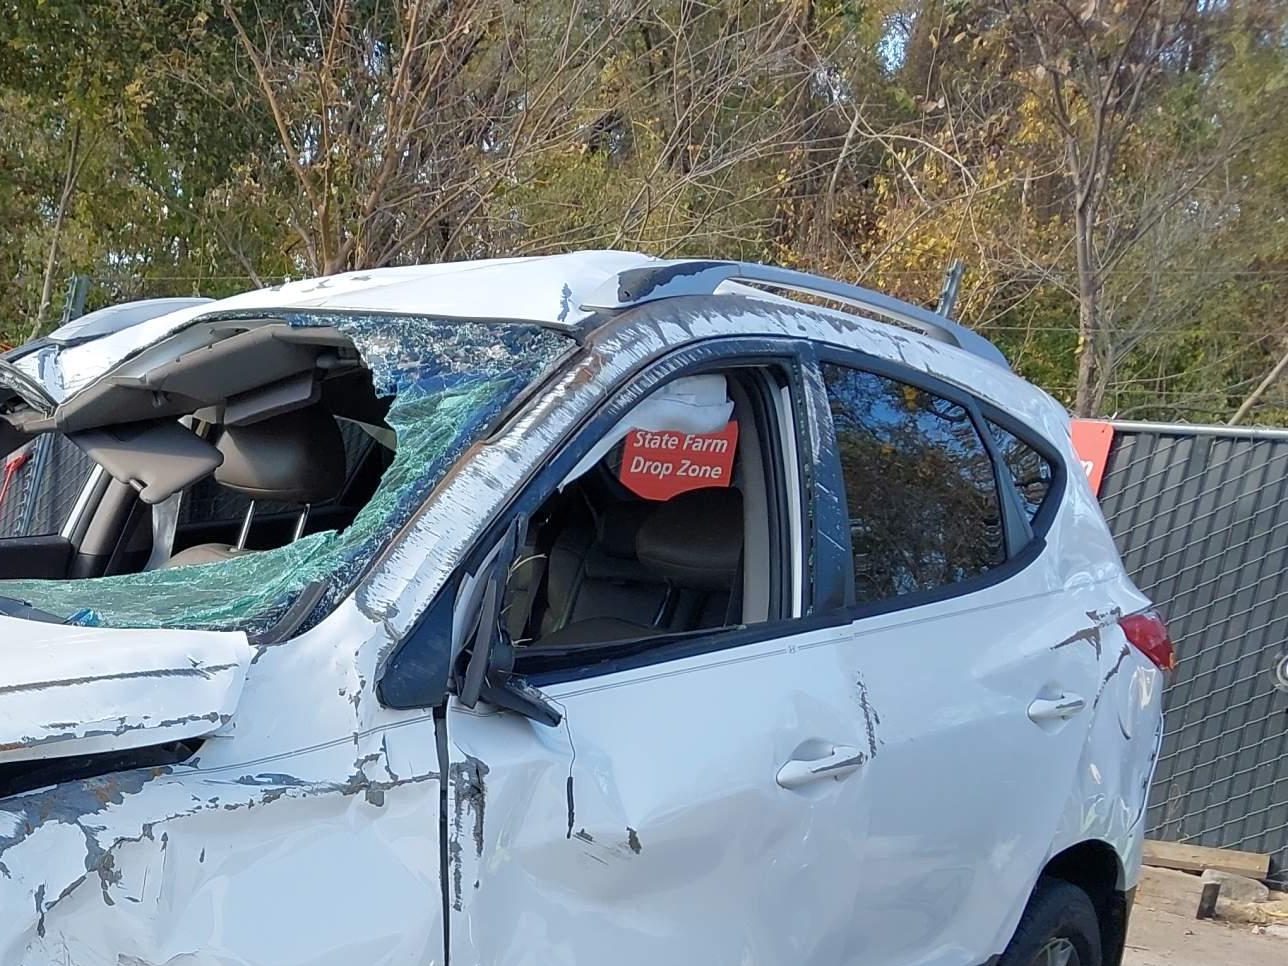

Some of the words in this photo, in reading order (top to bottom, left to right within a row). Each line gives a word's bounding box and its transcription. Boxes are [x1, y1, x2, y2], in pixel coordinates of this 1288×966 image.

[633, 431, 679, 450] State
[682, 434, 728, 453] Farm
[630, 456, 673, 479] Drop
[676, 459, 722, 478] Zone
